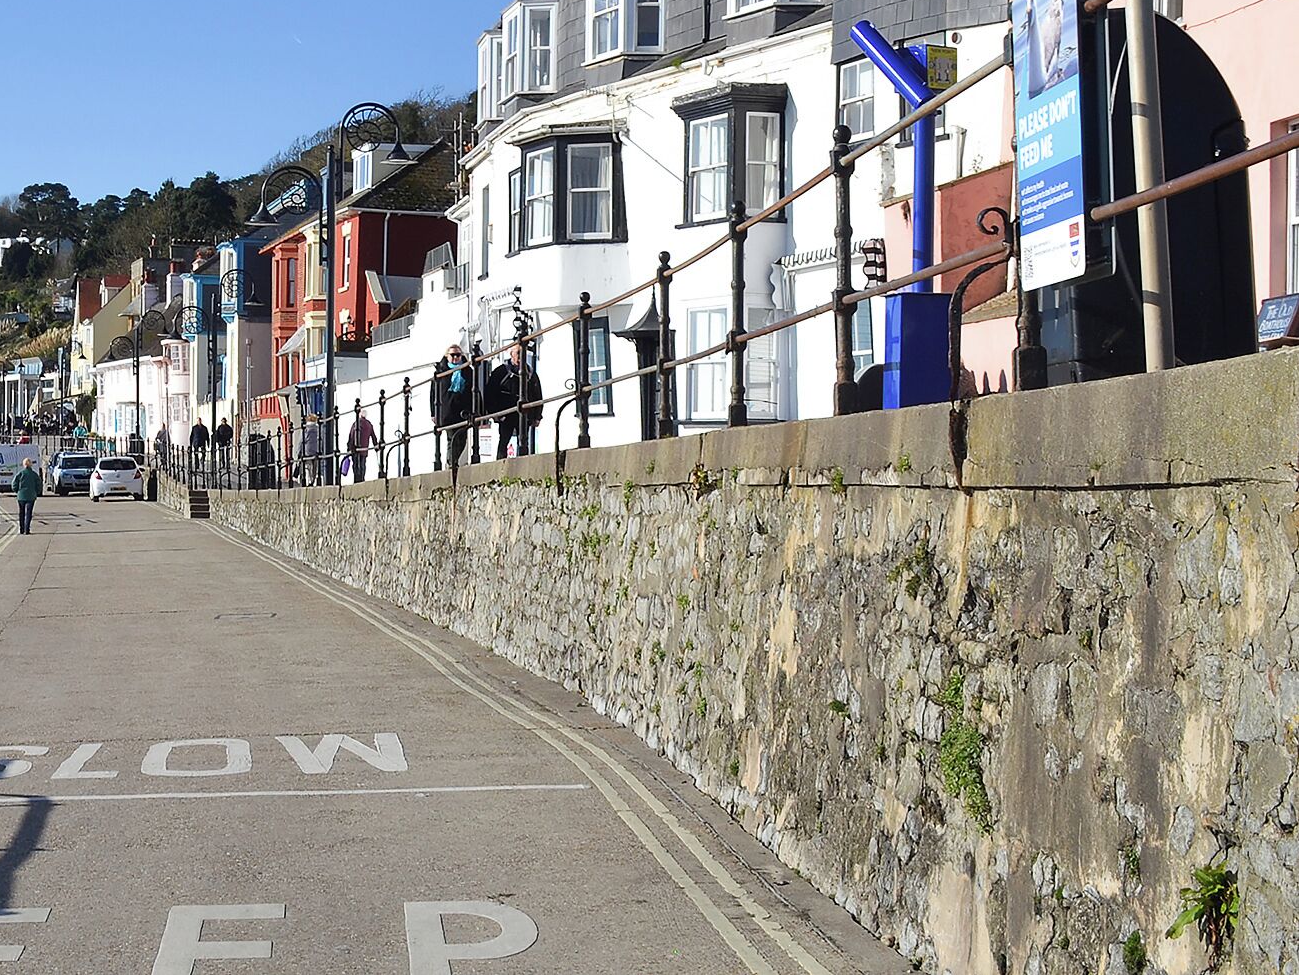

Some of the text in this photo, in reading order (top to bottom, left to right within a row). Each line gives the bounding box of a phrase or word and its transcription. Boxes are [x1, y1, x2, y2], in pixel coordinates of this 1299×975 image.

[1018, 89, 1077, 142] PLEASE DON'T
[1020, 133, 1054, 170] FEED ME
